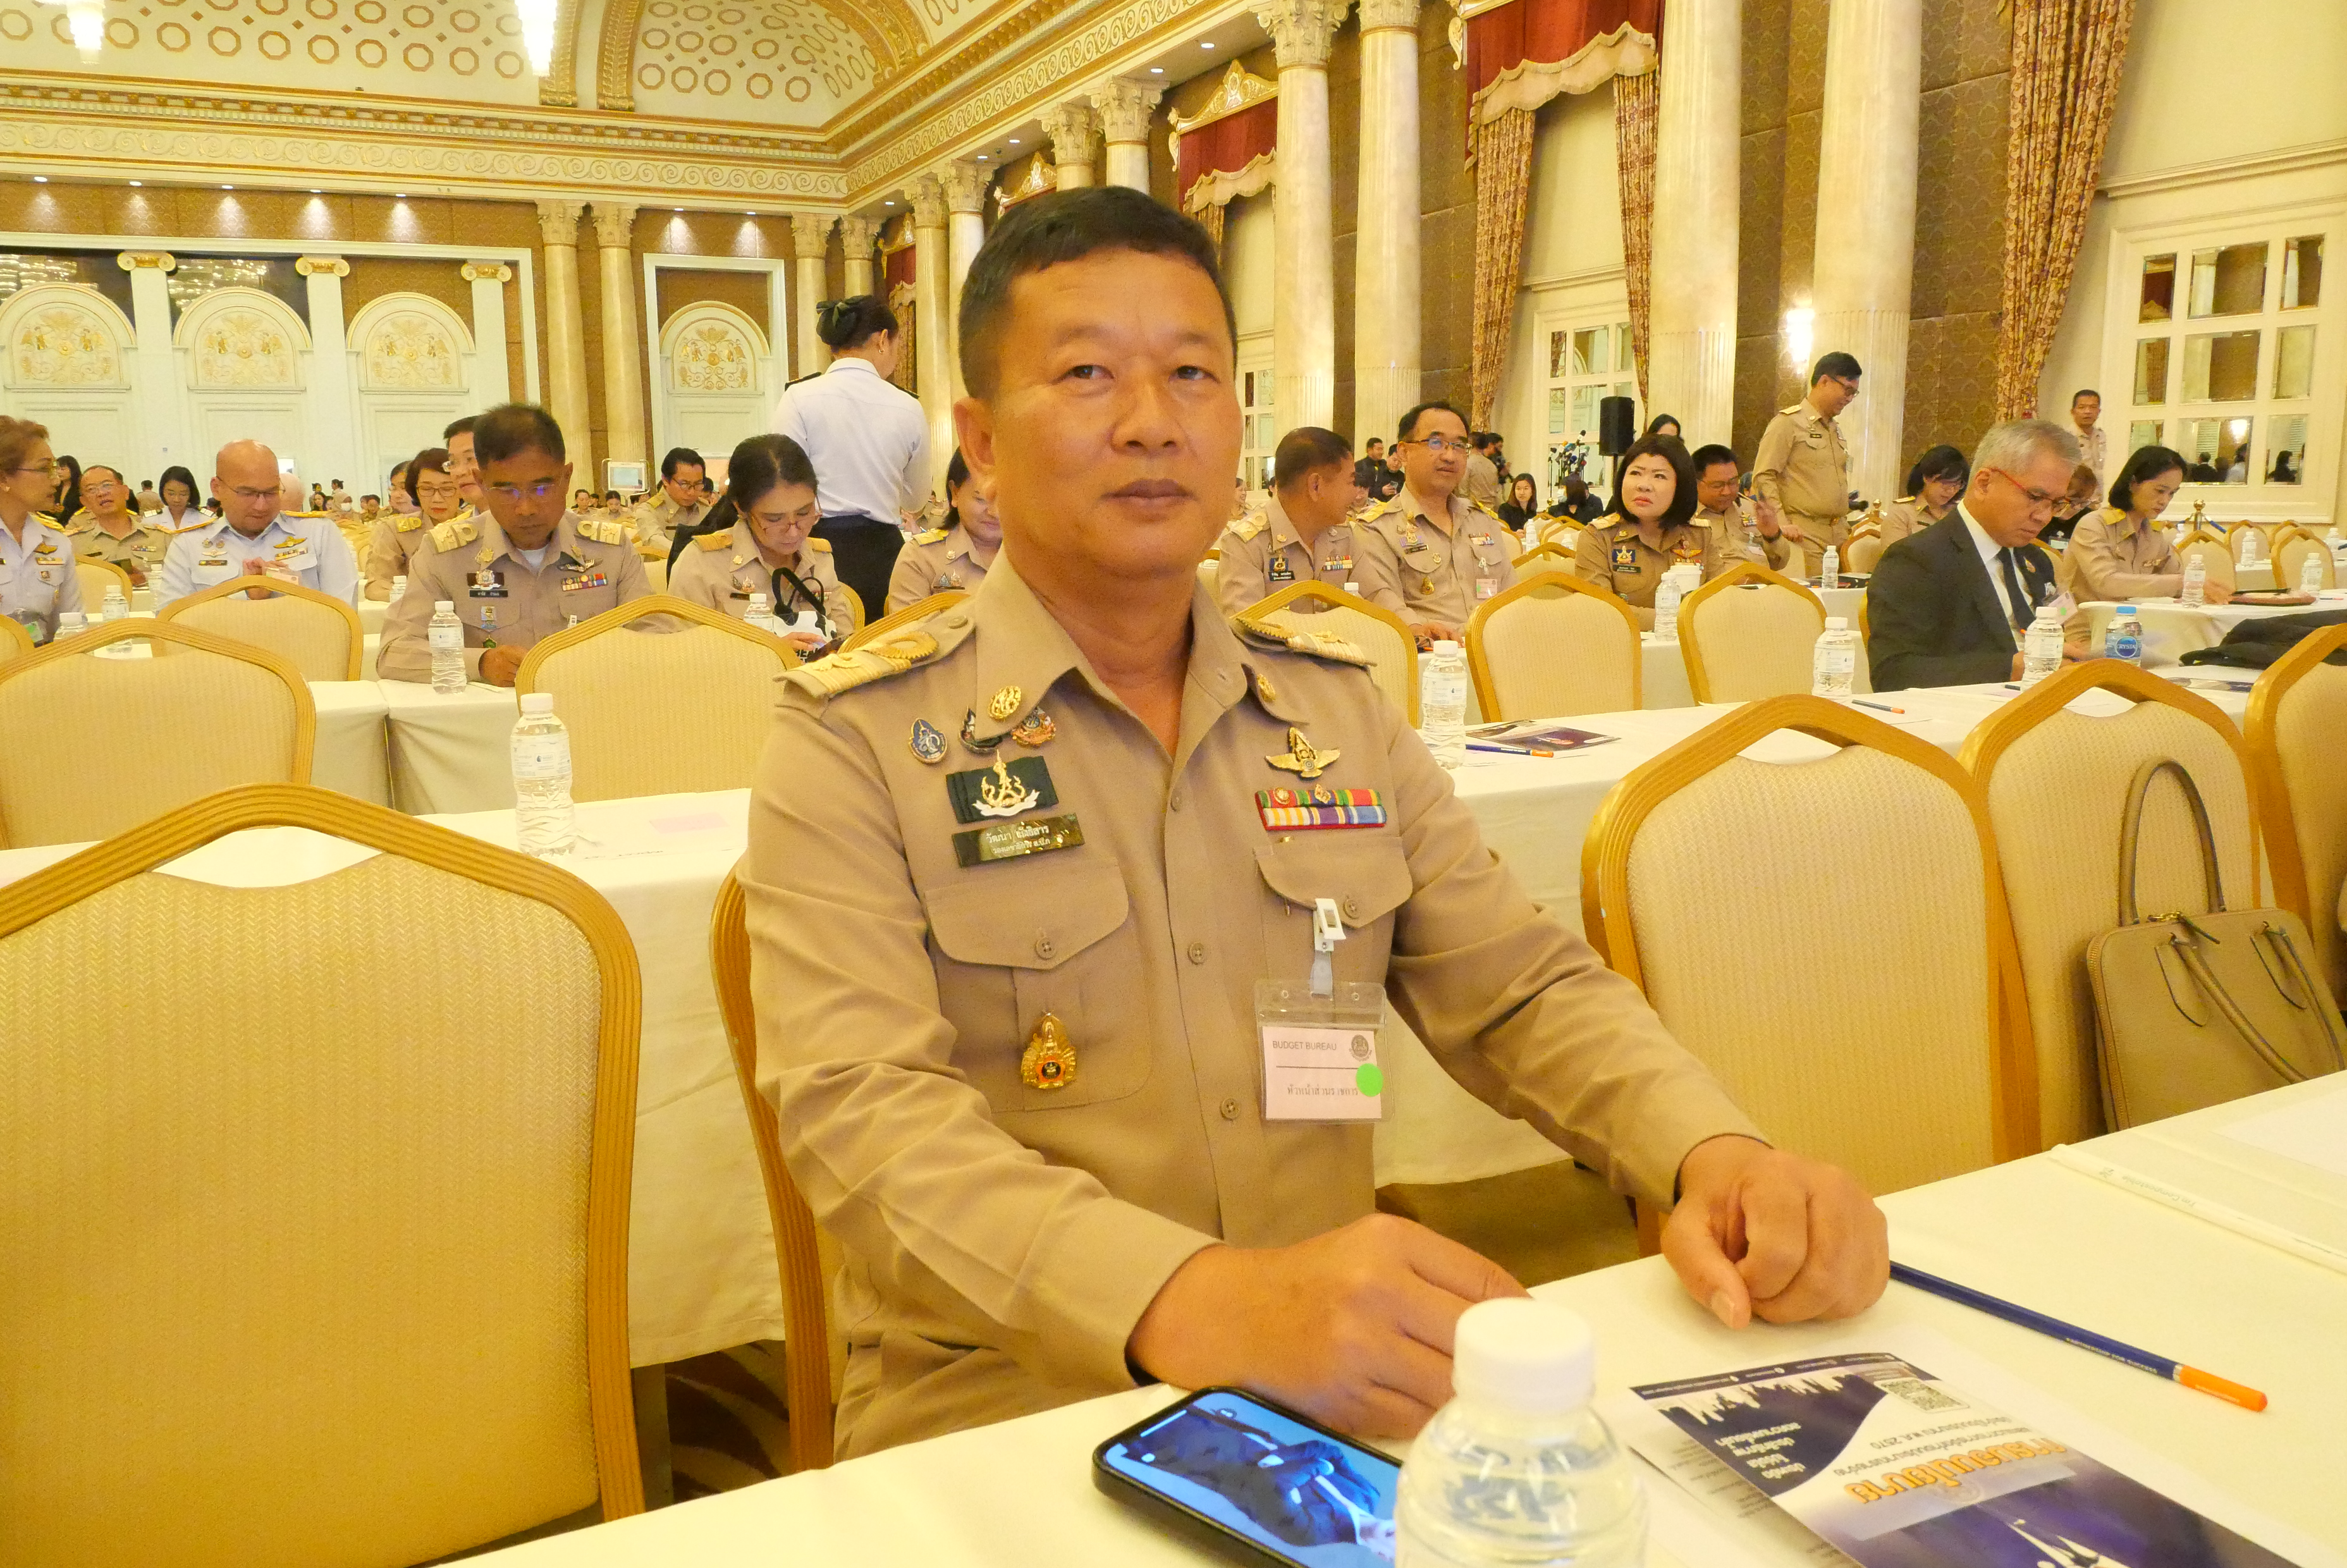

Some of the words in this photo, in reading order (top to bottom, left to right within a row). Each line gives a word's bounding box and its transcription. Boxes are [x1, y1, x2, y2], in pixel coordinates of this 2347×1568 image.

[986, 832, 1012, 843] วัฒนา
[1272, 1041, 1304, 1050] BUDGET
[1306, 1041, 1337, 1051] BUREAU
[1287, 1084, 1359, 1096] หัวหน้าส่วนราชการ
[2122, 1176, 2180, 1202] Compostable
[1870, 1436, 1903, 1449] 2570
[1844, 1437, 2068, 1504] การมอบนโยบาย
